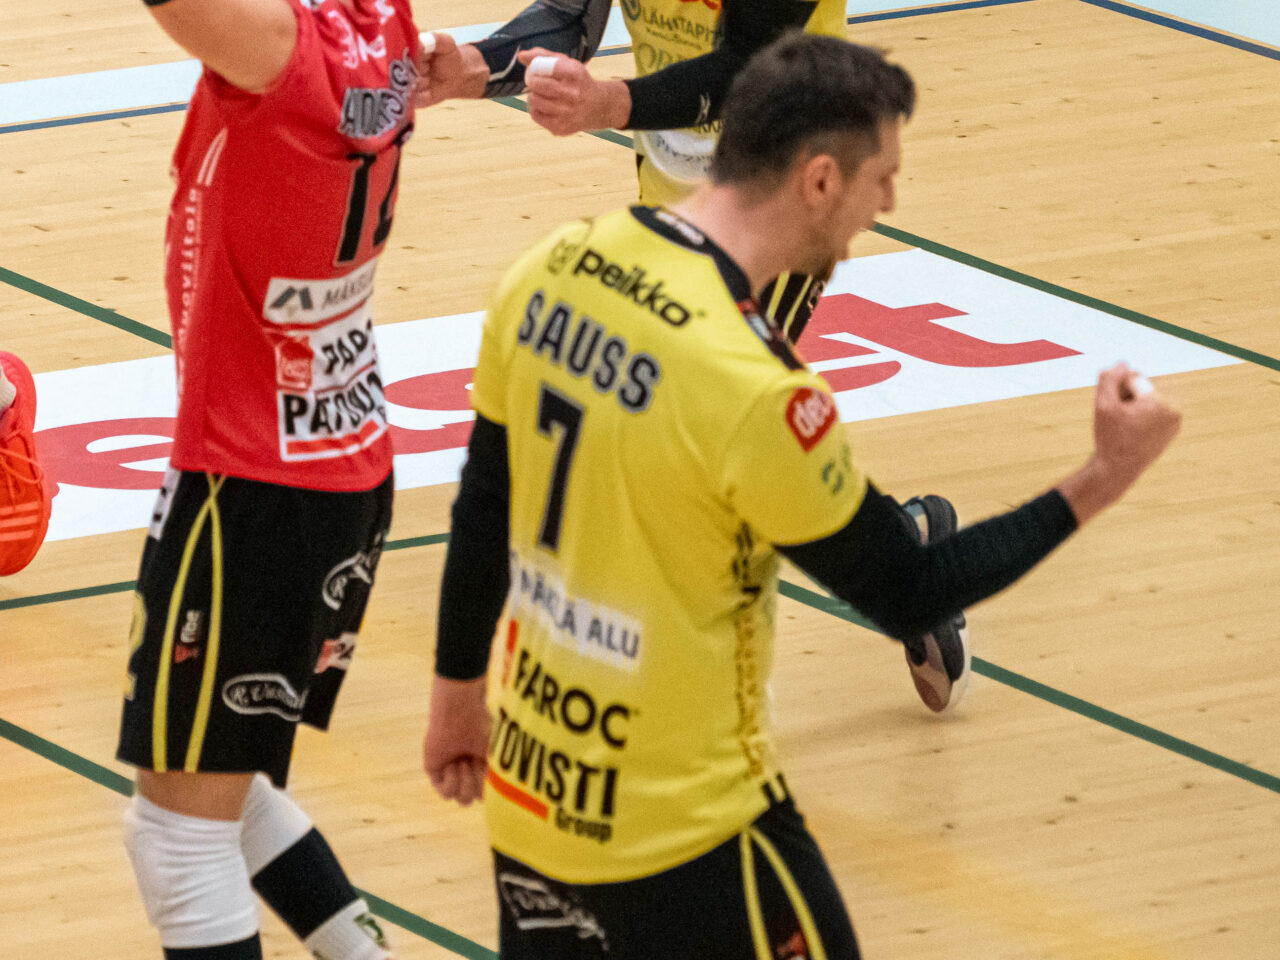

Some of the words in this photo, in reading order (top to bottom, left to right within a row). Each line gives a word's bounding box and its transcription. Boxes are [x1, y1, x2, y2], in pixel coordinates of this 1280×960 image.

[573, 246, 691, 329] peikko
[517, 289, 660, 415] SAUSS
[536, 381, 587, 555] 7
[587, 616, 640, 659] ALU
